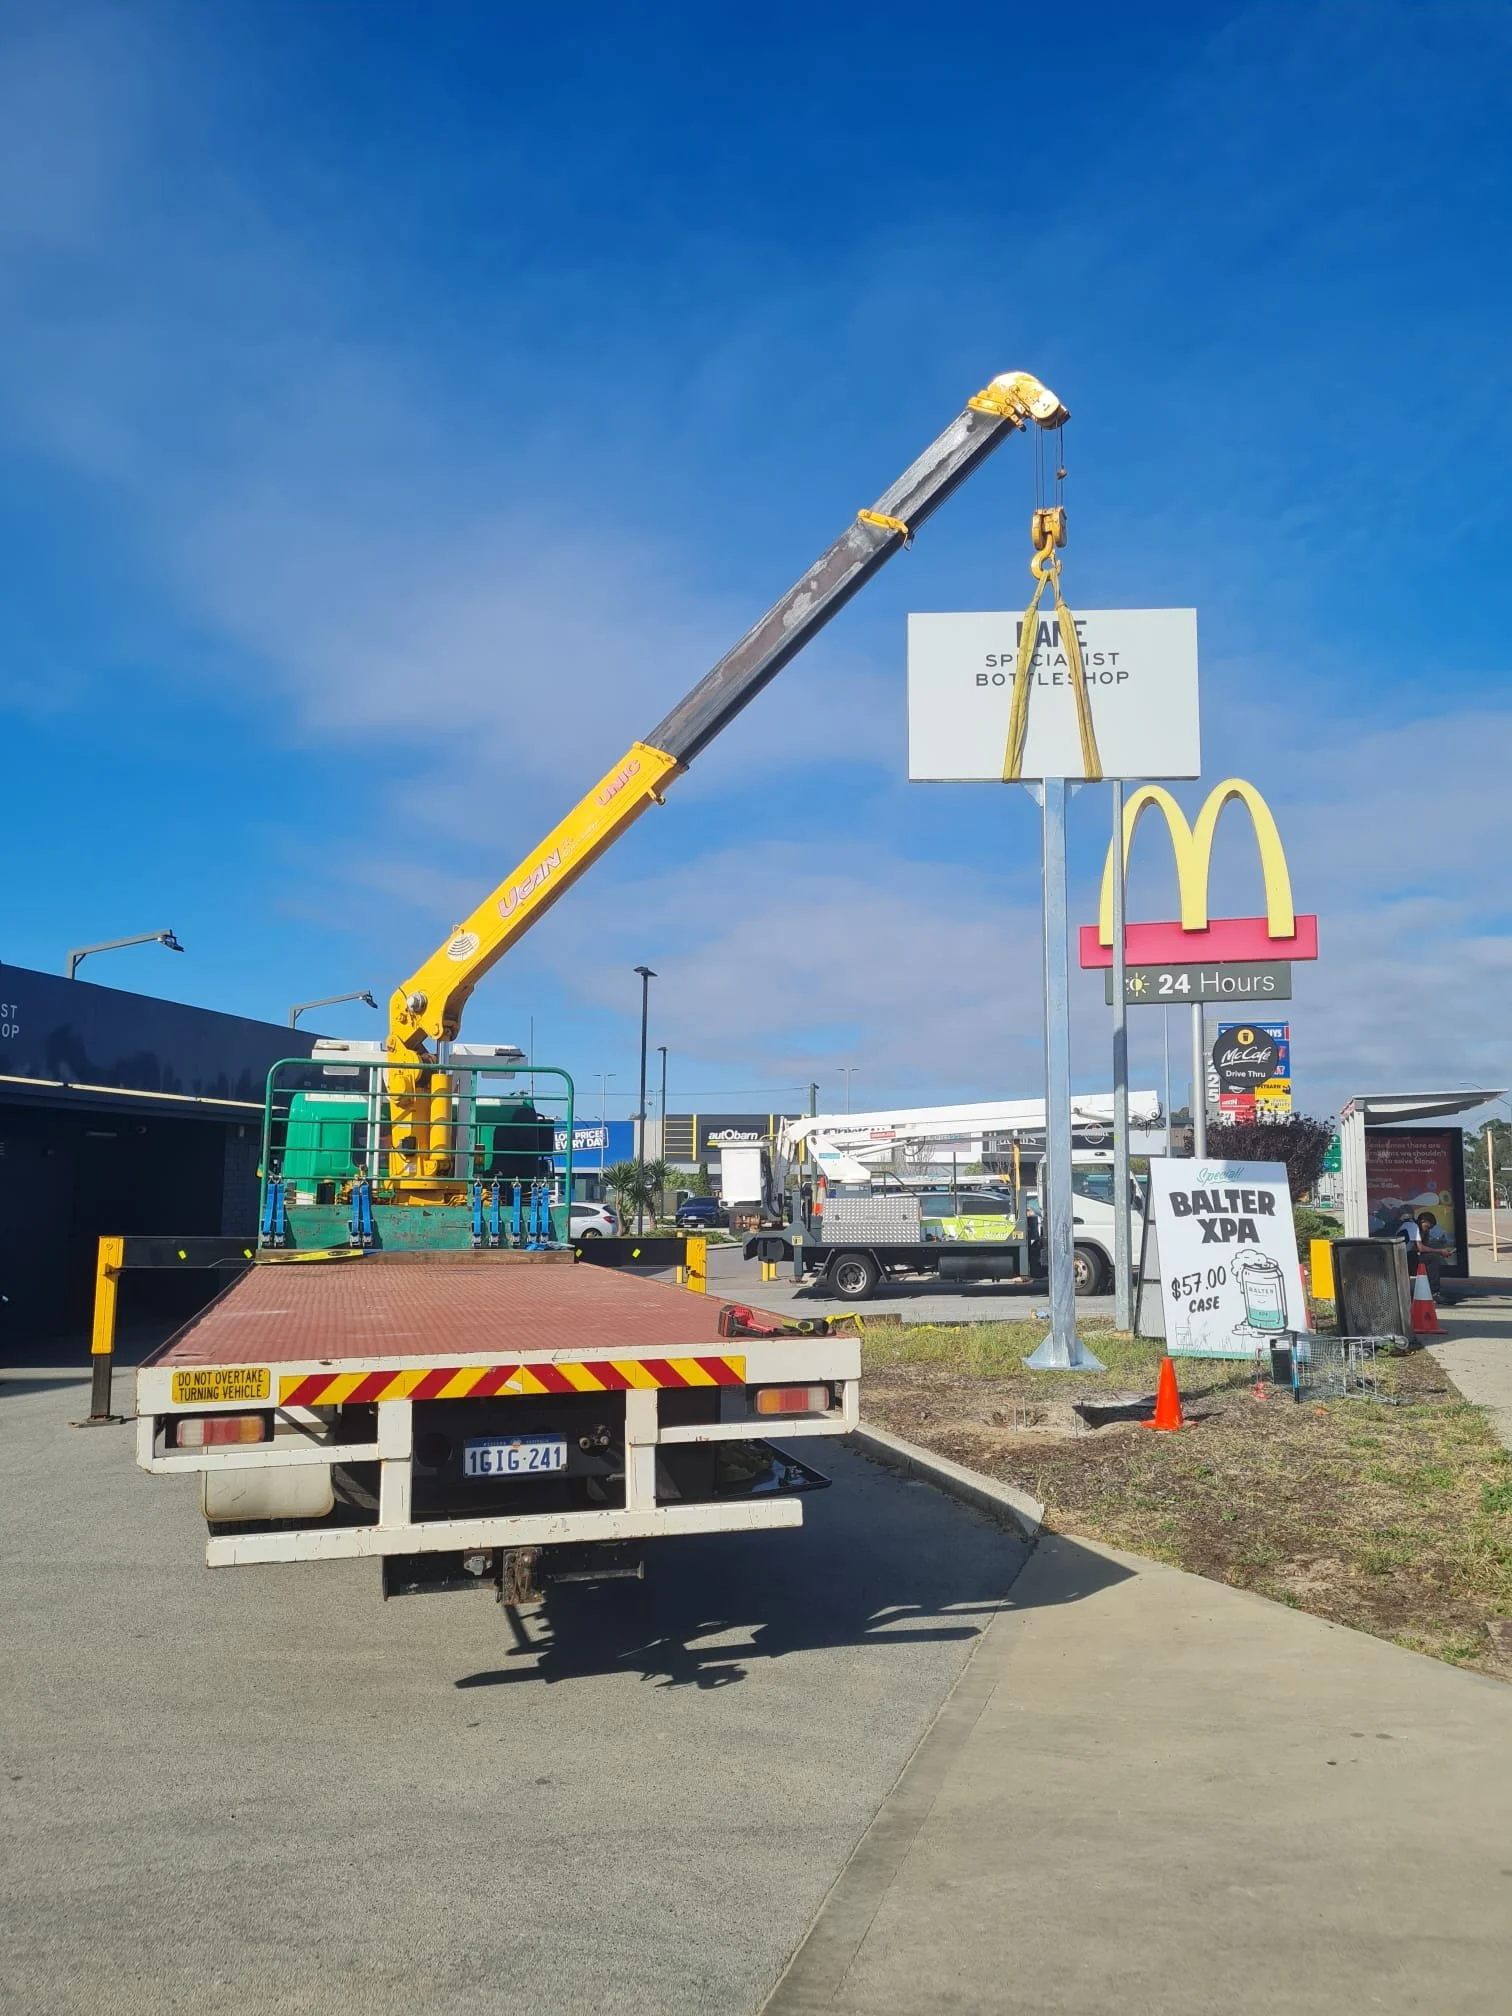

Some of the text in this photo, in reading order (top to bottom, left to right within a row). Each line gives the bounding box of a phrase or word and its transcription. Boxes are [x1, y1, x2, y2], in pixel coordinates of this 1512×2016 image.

[985, 652, 1120, 668] SPCIAIST
[594, 759, 641, 807] UNIC
[1158, 971, 1275, 995] 24 Hours
[1221, 1046, 1272, 1066] McCafé
[1226, 1070, 1266, 1078] Drive Thru
[555, 1137, 603, 1150] EVRY DAY
[574, 1130, 604, 1140] PRICES
[1169, 1189, 1276, 1217] BALTER
[1197, 1217, 1260, 1244] XPA
[1171, 1266, 1227, 1301] $57.00
[1189, 1295, 1220, 1313] CASE
[178, 1369, 263, 1387] DO NOT OVERTAKE
[179, 1384, 262, 1401] TURNING VEHICLE
